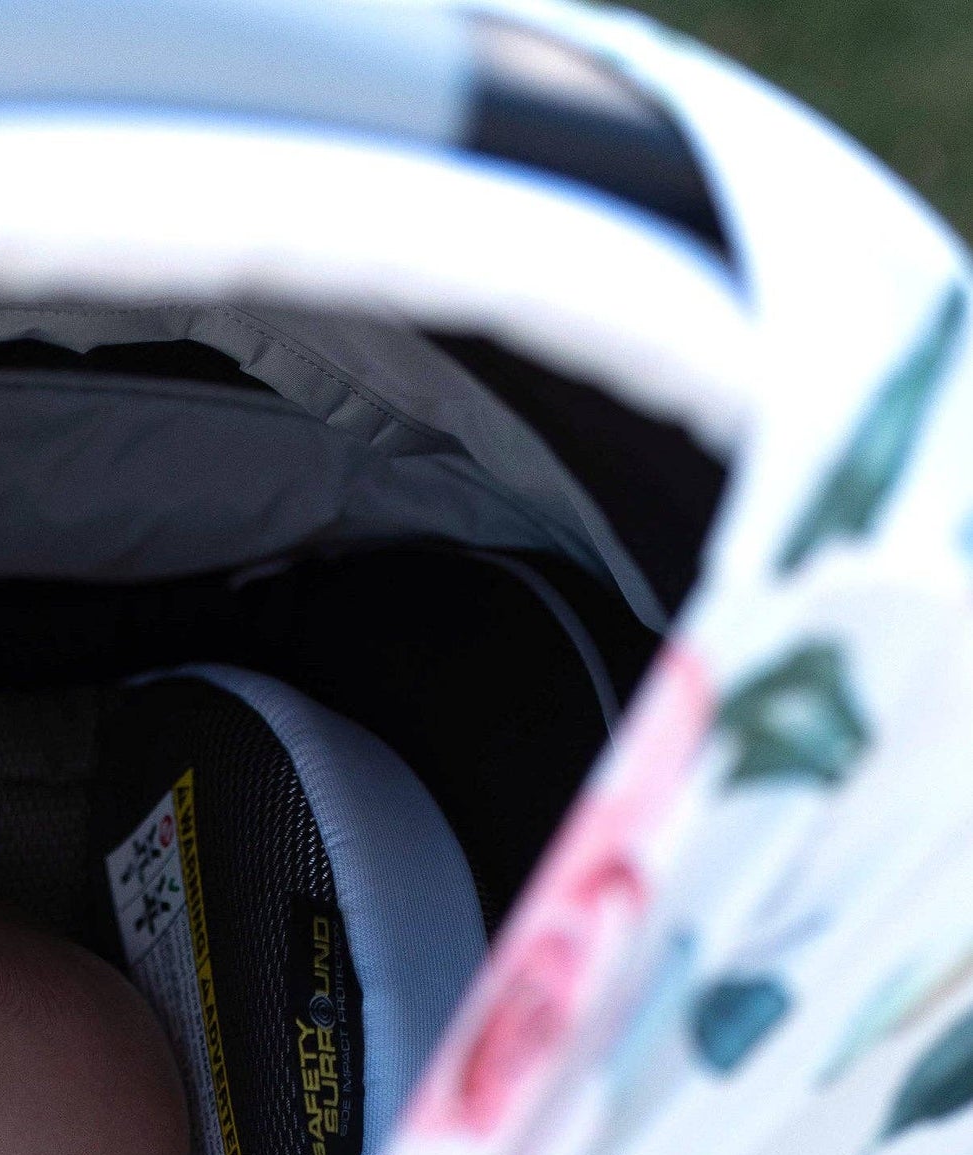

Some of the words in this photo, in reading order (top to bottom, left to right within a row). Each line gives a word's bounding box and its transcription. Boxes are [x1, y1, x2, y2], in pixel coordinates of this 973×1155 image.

[180, 807, 207, 955] WARNING
[308, 914, 339, 1134] SURROUND
[339, 1027, 353, 1093] IMPACT
[340, 1099, 352, 1137] SIDE
